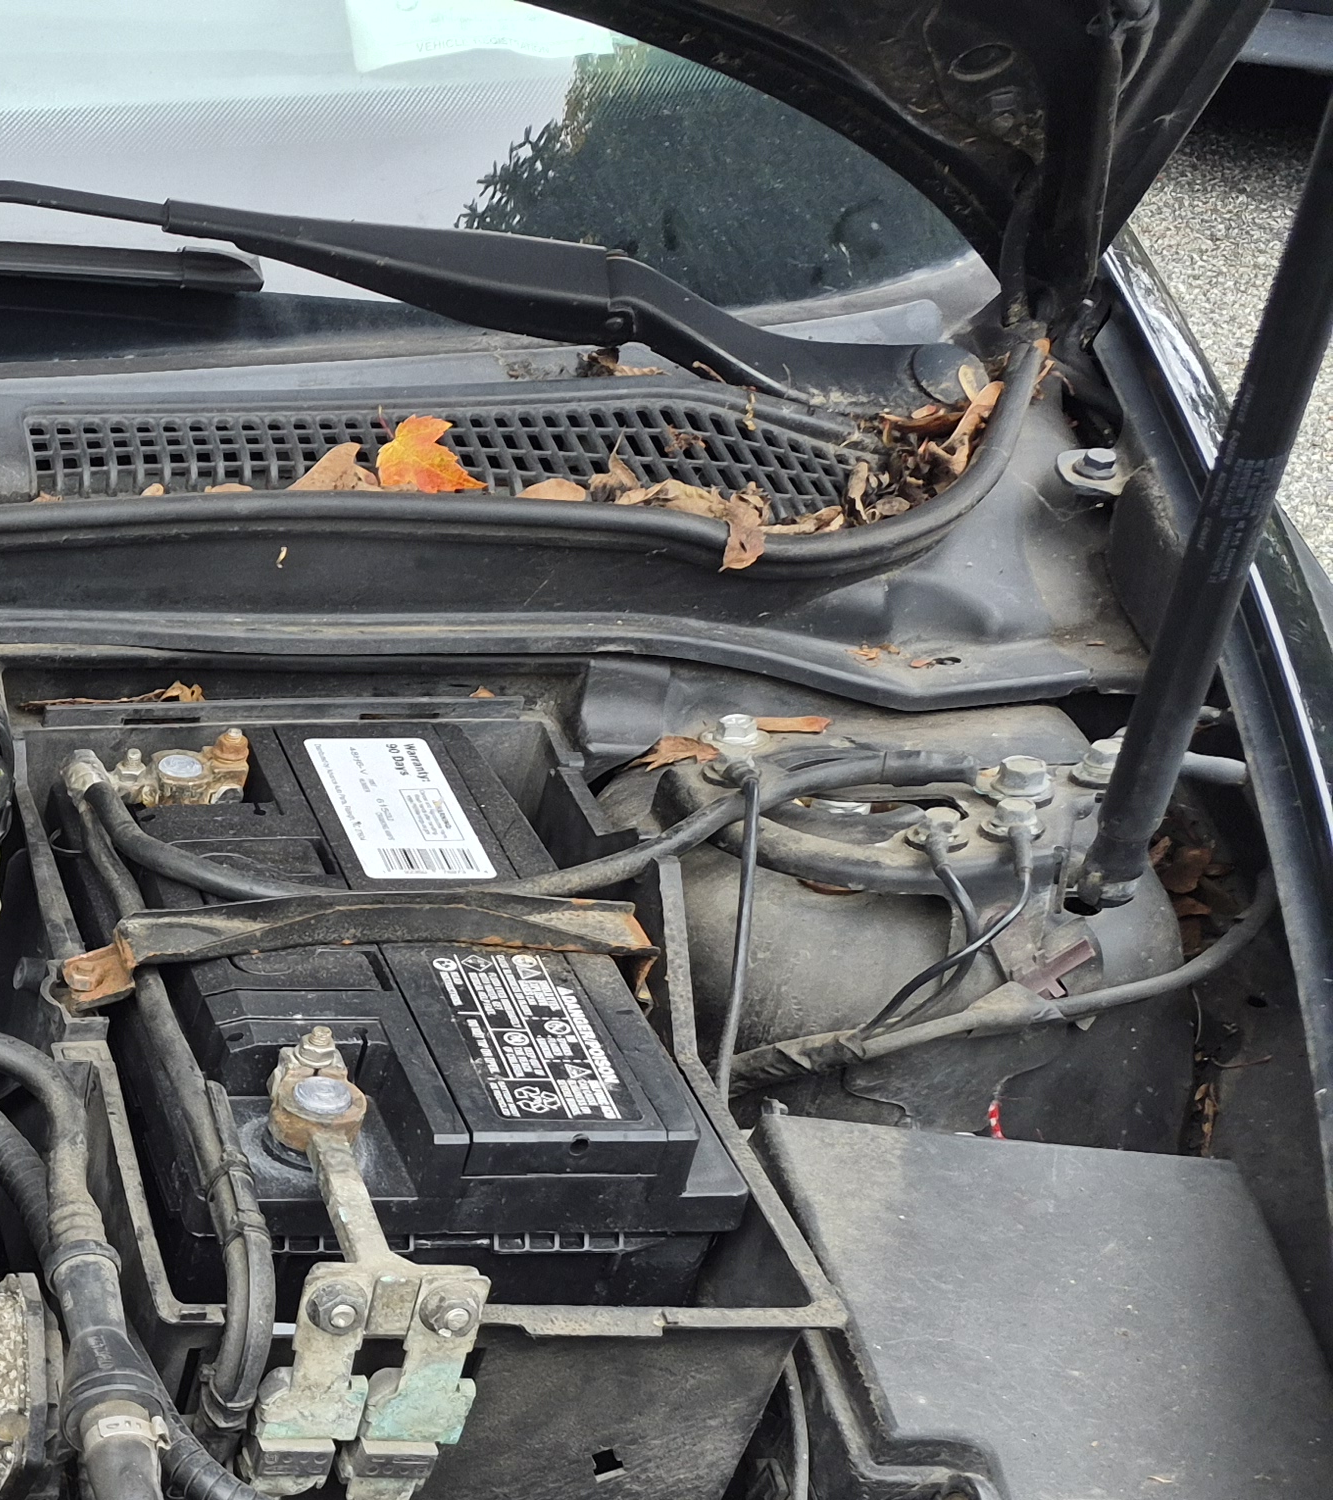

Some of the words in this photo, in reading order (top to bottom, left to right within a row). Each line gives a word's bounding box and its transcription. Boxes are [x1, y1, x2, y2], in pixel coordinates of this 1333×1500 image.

[384, 743, 401, 753] 90
[402, 743, 432, 781] Warranty:
[389, 756, 412, 775] Days
[561, 995, 617, 1083] DANGER/POISON
